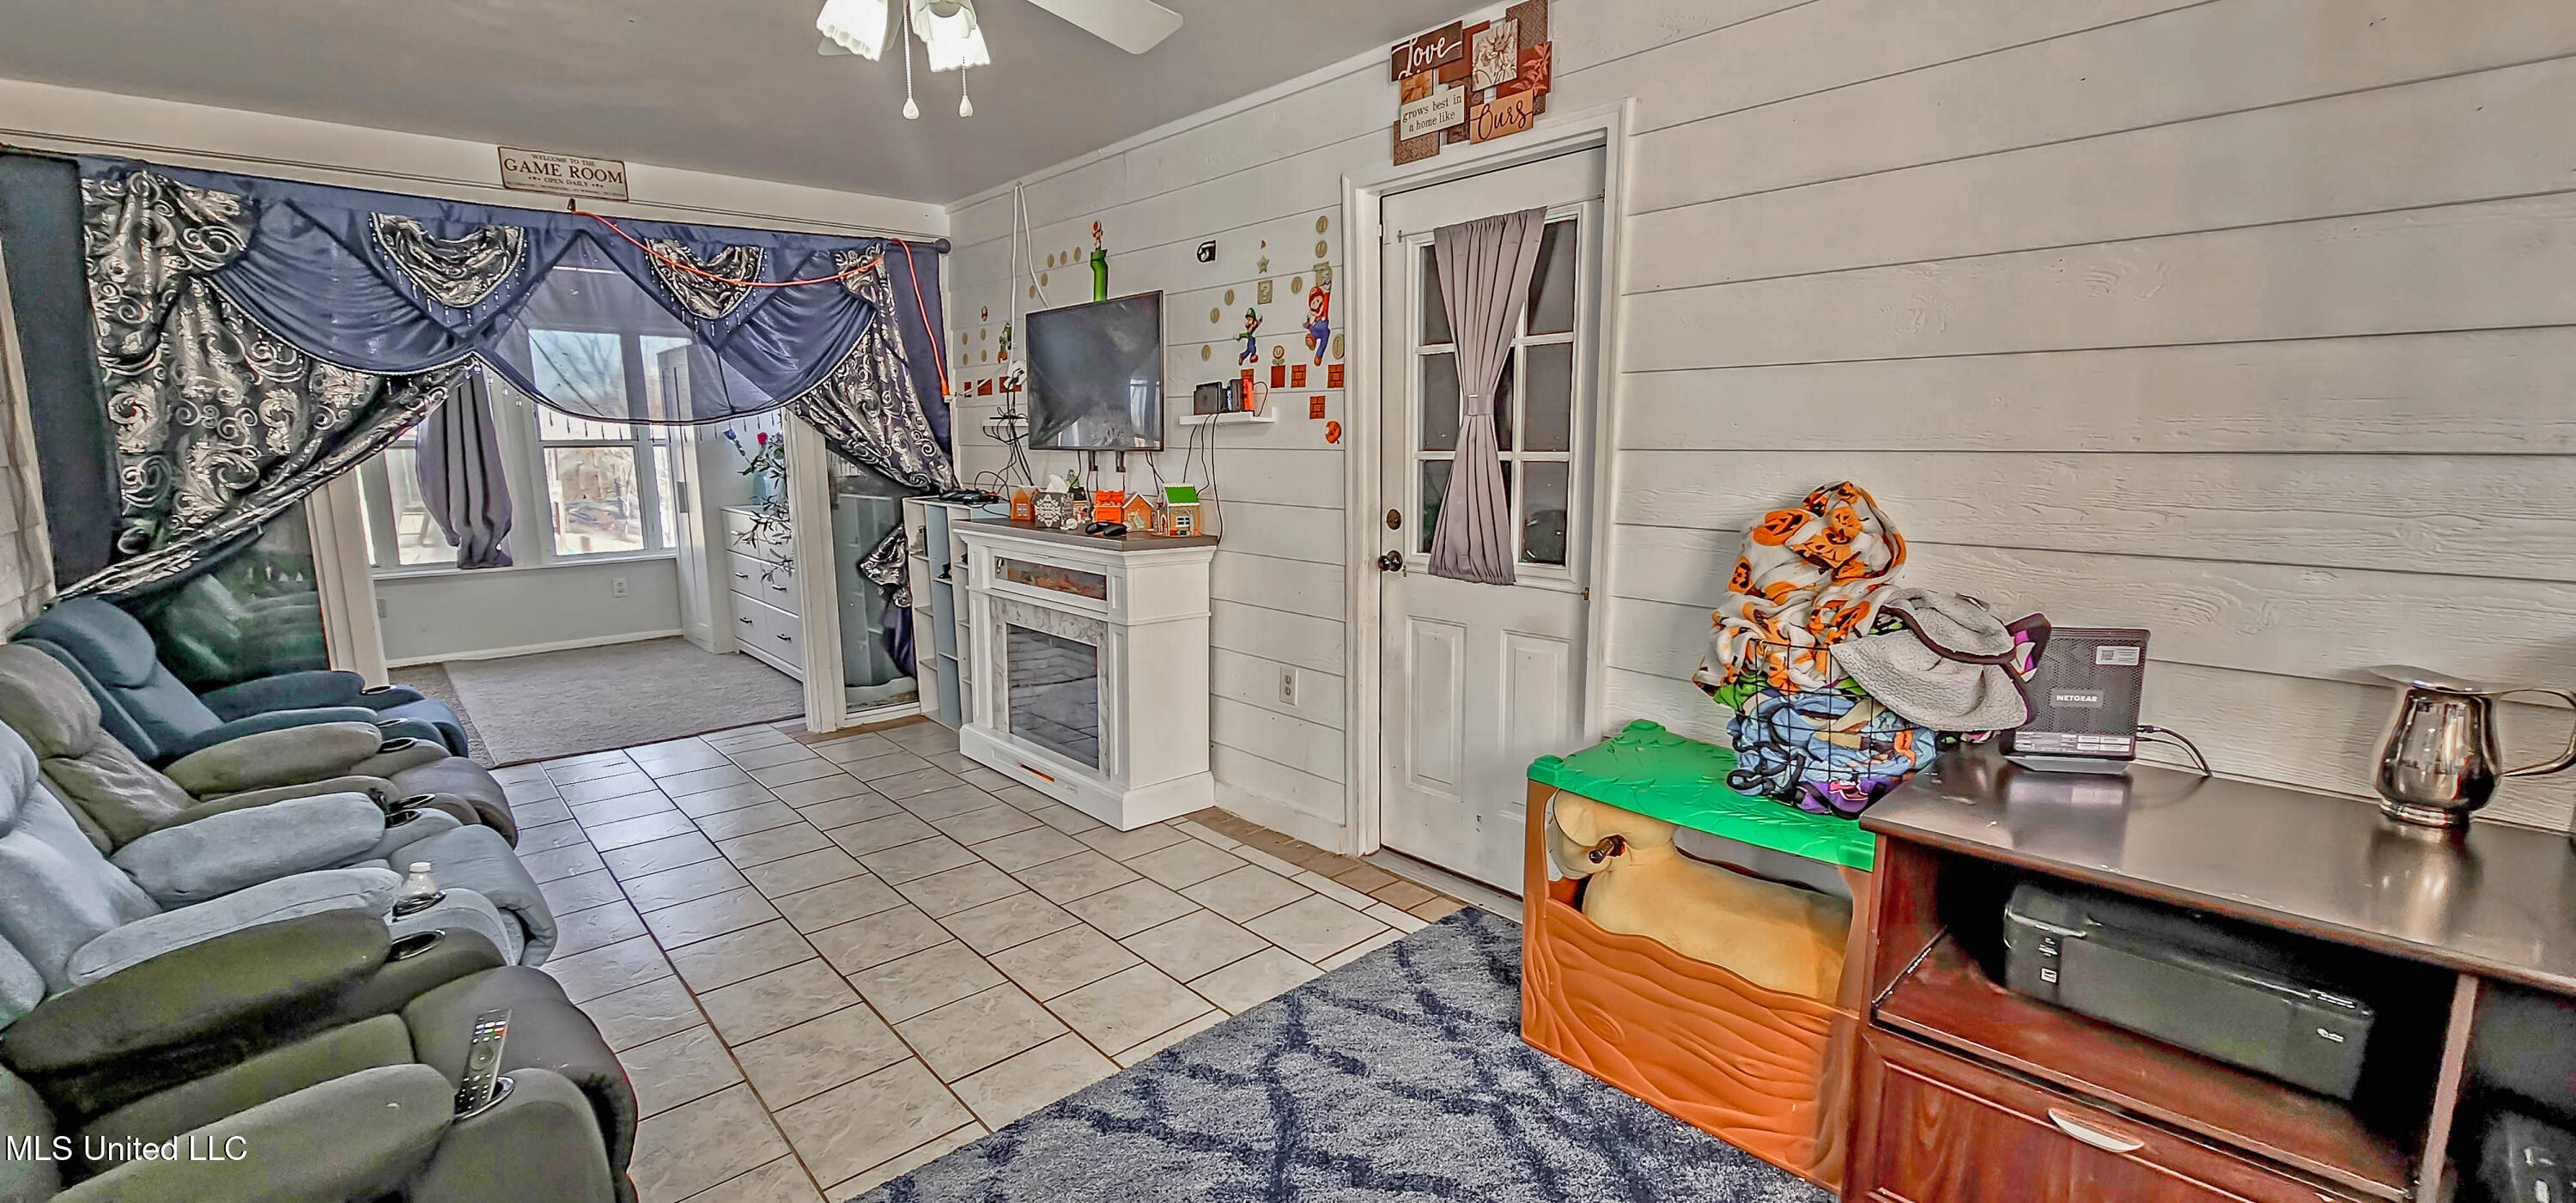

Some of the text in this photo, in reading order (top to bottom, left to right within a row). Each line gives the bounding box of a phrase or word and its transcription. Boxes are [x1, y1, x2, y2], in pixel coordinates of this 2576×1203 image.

[1391, 36, 1462, 80] Love
[1402, 94, 1462, 123] grows best in
[1416, 118, 1437, 131] home
[1439, 111, 1455, 124] like
[1471, 100, 1534, 140] Ours
[504, 158, 623, 184] GAME ROOM
[532, 154, 567, 163] WELCOME
[2057, 694, 2098, 702] NETGEAR
